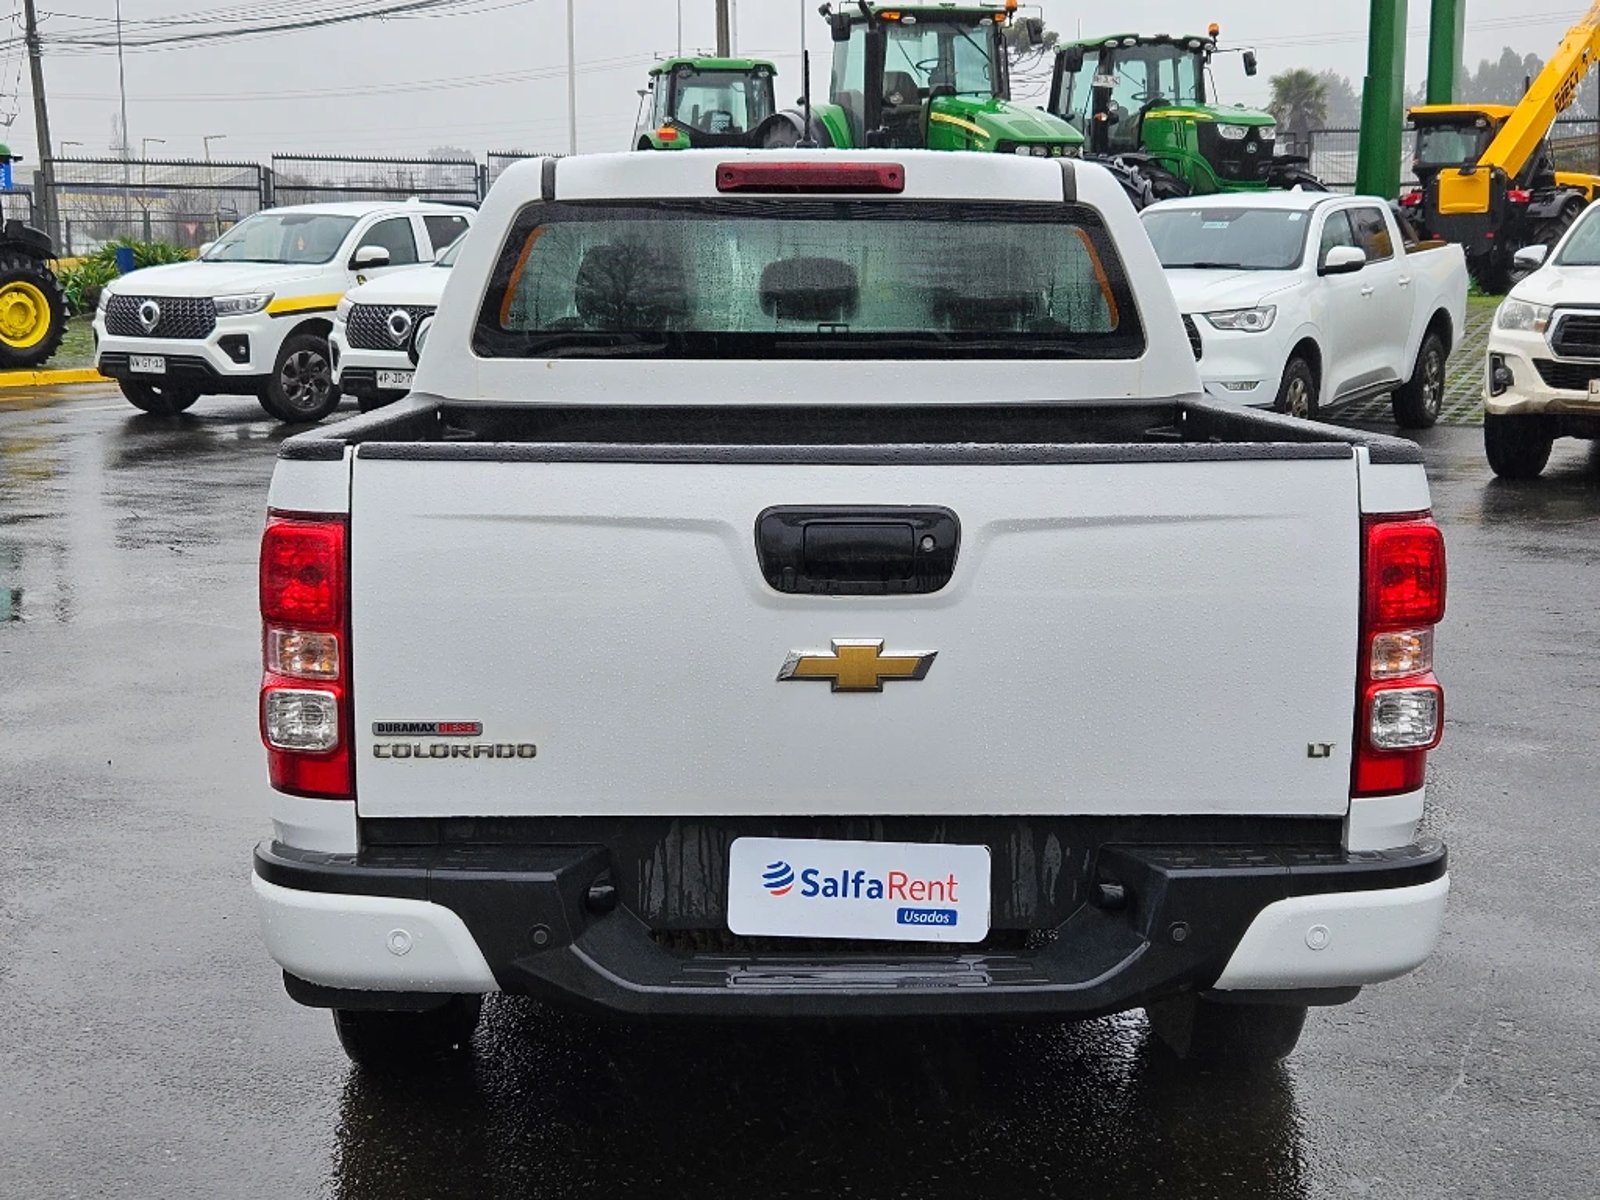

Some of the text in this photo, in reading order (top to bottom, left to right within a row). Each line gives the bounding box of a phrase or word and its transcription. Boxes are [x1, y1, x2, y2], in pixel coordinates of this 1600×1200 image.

[377, 722, 479, 733] DURAMAX DIESEL
[373, 743, 537, 759] COLORADO
[1307, 741, 1337, 758] LT
[800, 868, 959, 902] SalfaRent
[904, 910, 951, 925] Usados
